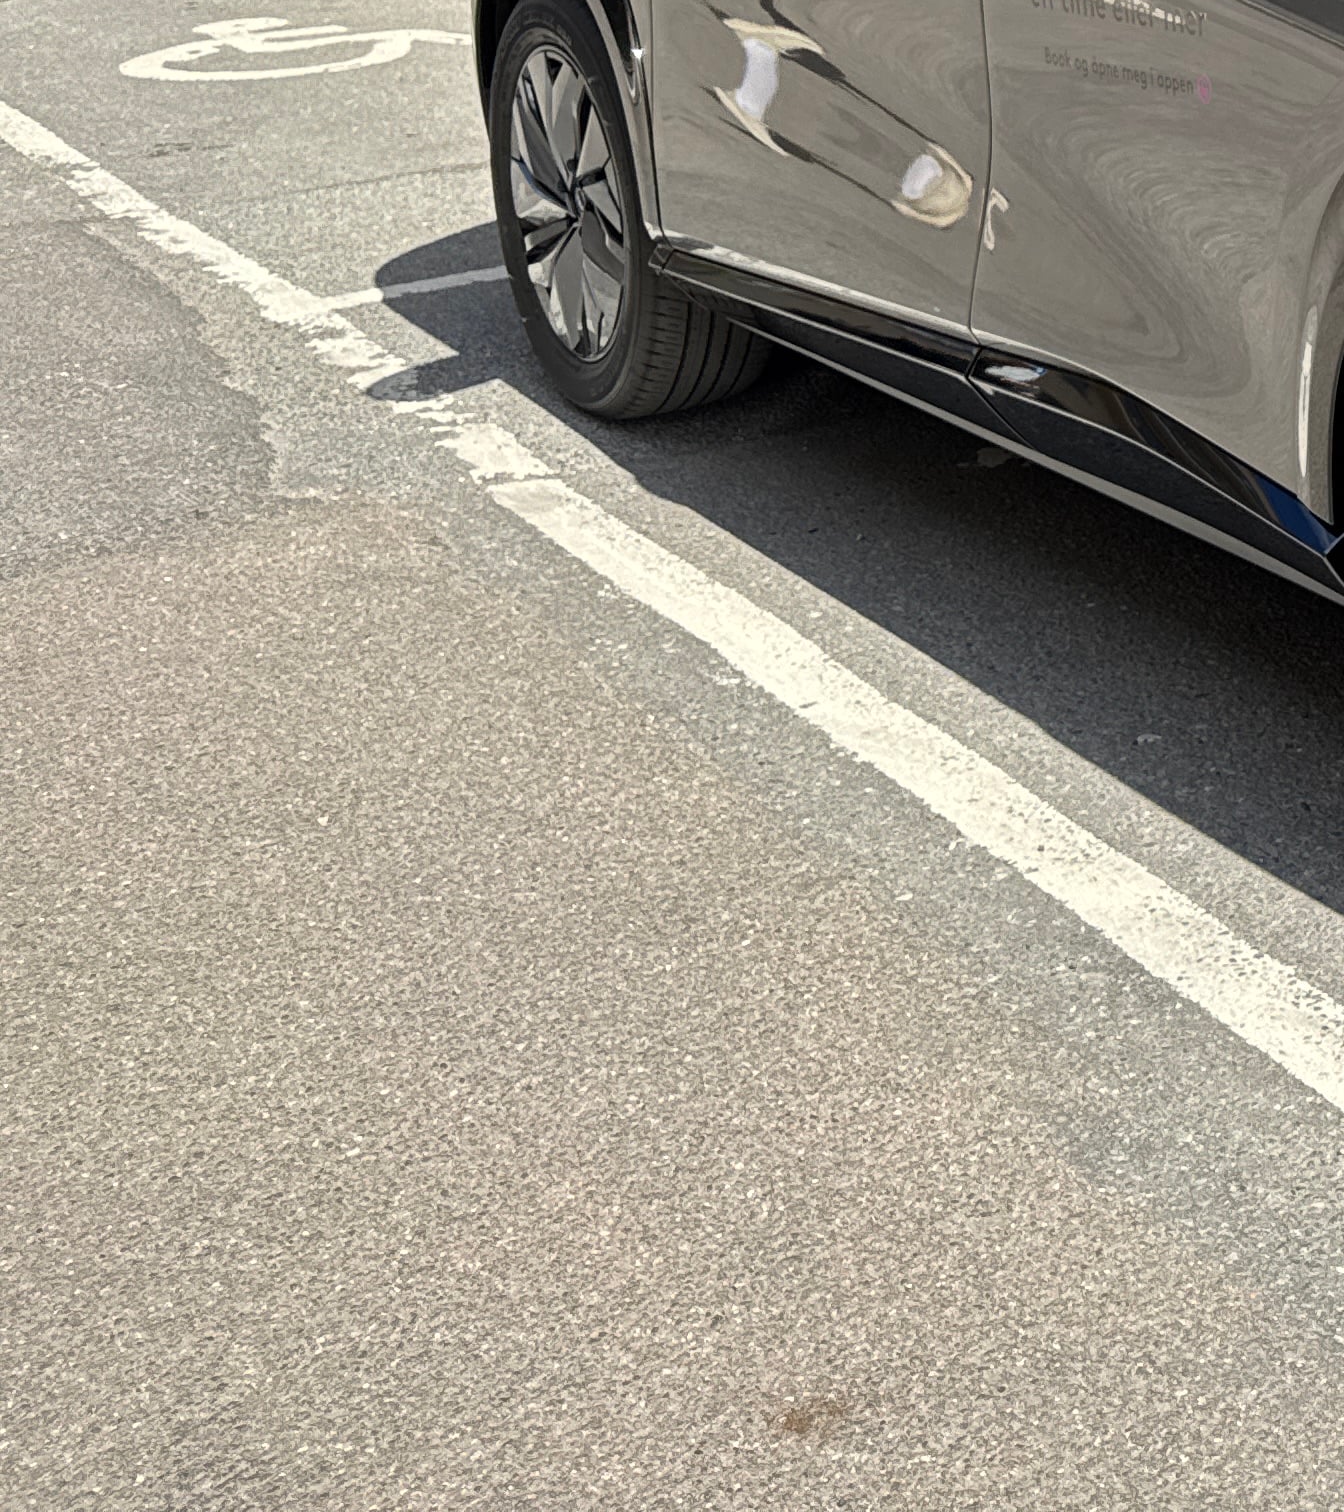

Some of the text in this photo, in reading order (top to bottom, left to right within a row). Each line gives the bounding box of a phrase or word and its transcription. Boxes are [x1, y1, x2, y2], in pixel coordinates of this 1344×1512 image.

[1044, 46, 1073, 67] Book
[1074, 57, 1089, 78] og
[1122, 66, 1148, 89] meg
[1157, 73, 1195, 96] appen
